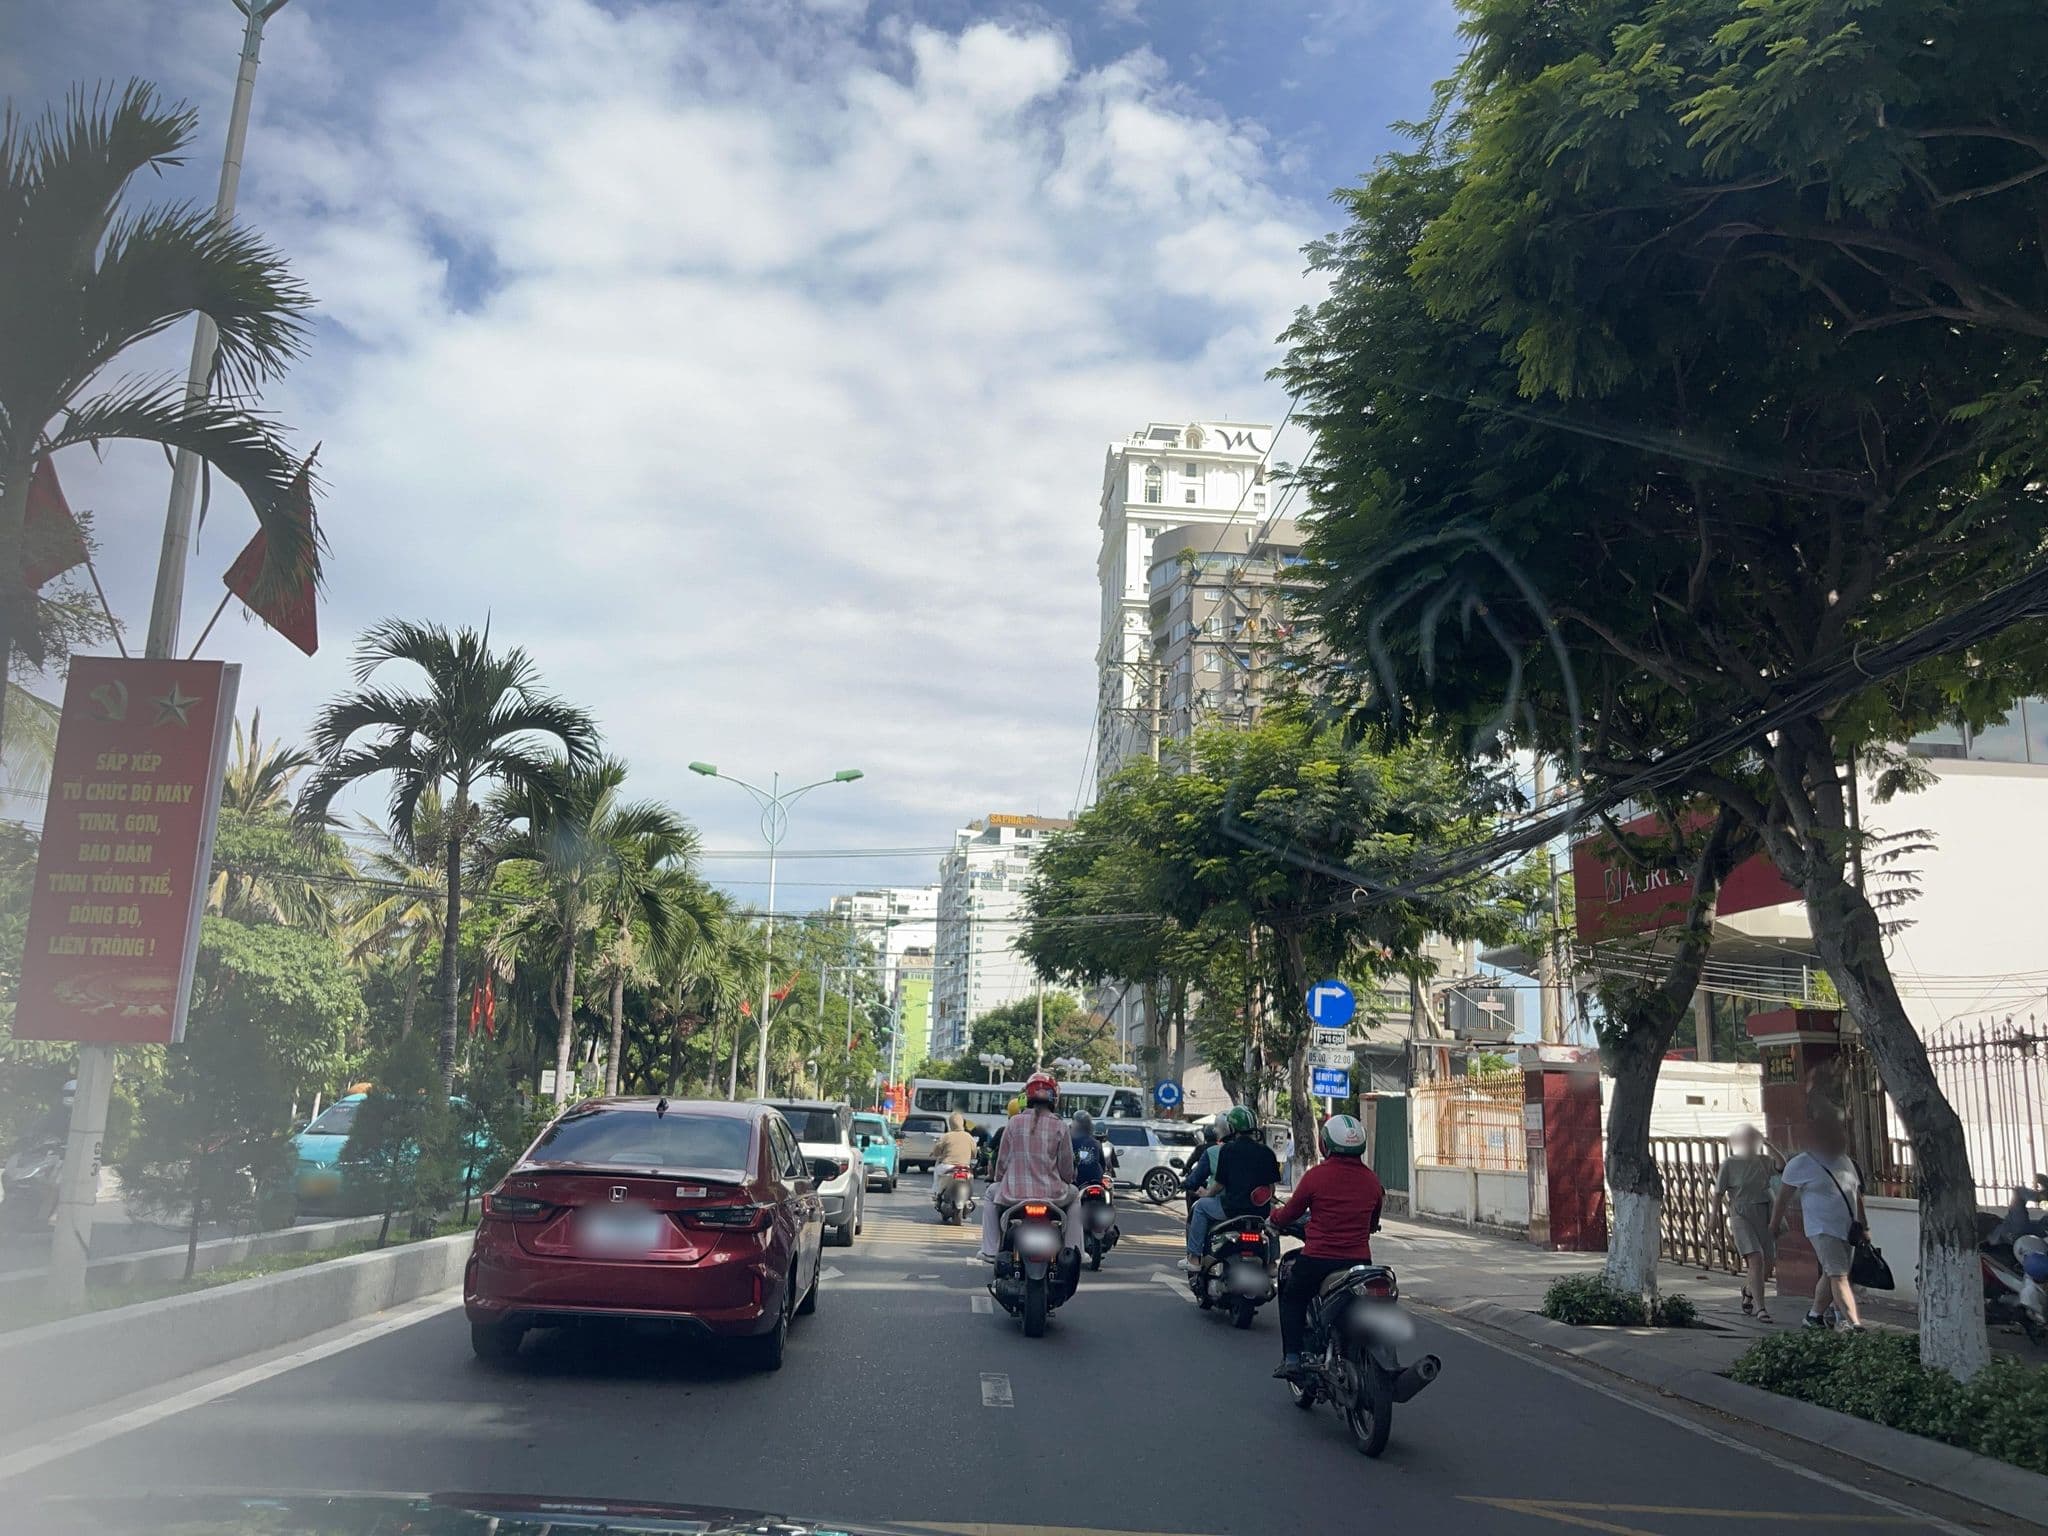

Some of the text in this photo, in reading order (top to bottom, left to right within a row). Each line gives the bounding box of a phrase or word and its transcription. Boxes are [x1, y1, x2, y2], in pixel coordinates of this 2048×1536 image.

[96, 748, 162, 772] SẮP XẾP
[86, 781, 128, 801] CHỨC
[130, 781, 152, 805] BỘ
[155, 782, 194, 803] MÁY
[125, 814, 161, 835] GỌN,
[78, 839, 110, 862] BẢO
[92, 866, 134, 893] TỔNG
[139, 868, 173, 896] THỂ,
[68, 901, 142, 928] ĐỒNG BỘ,
[48, 932, 86, 954] LIÊN
[91, 933, 145, 956] THÔNG
